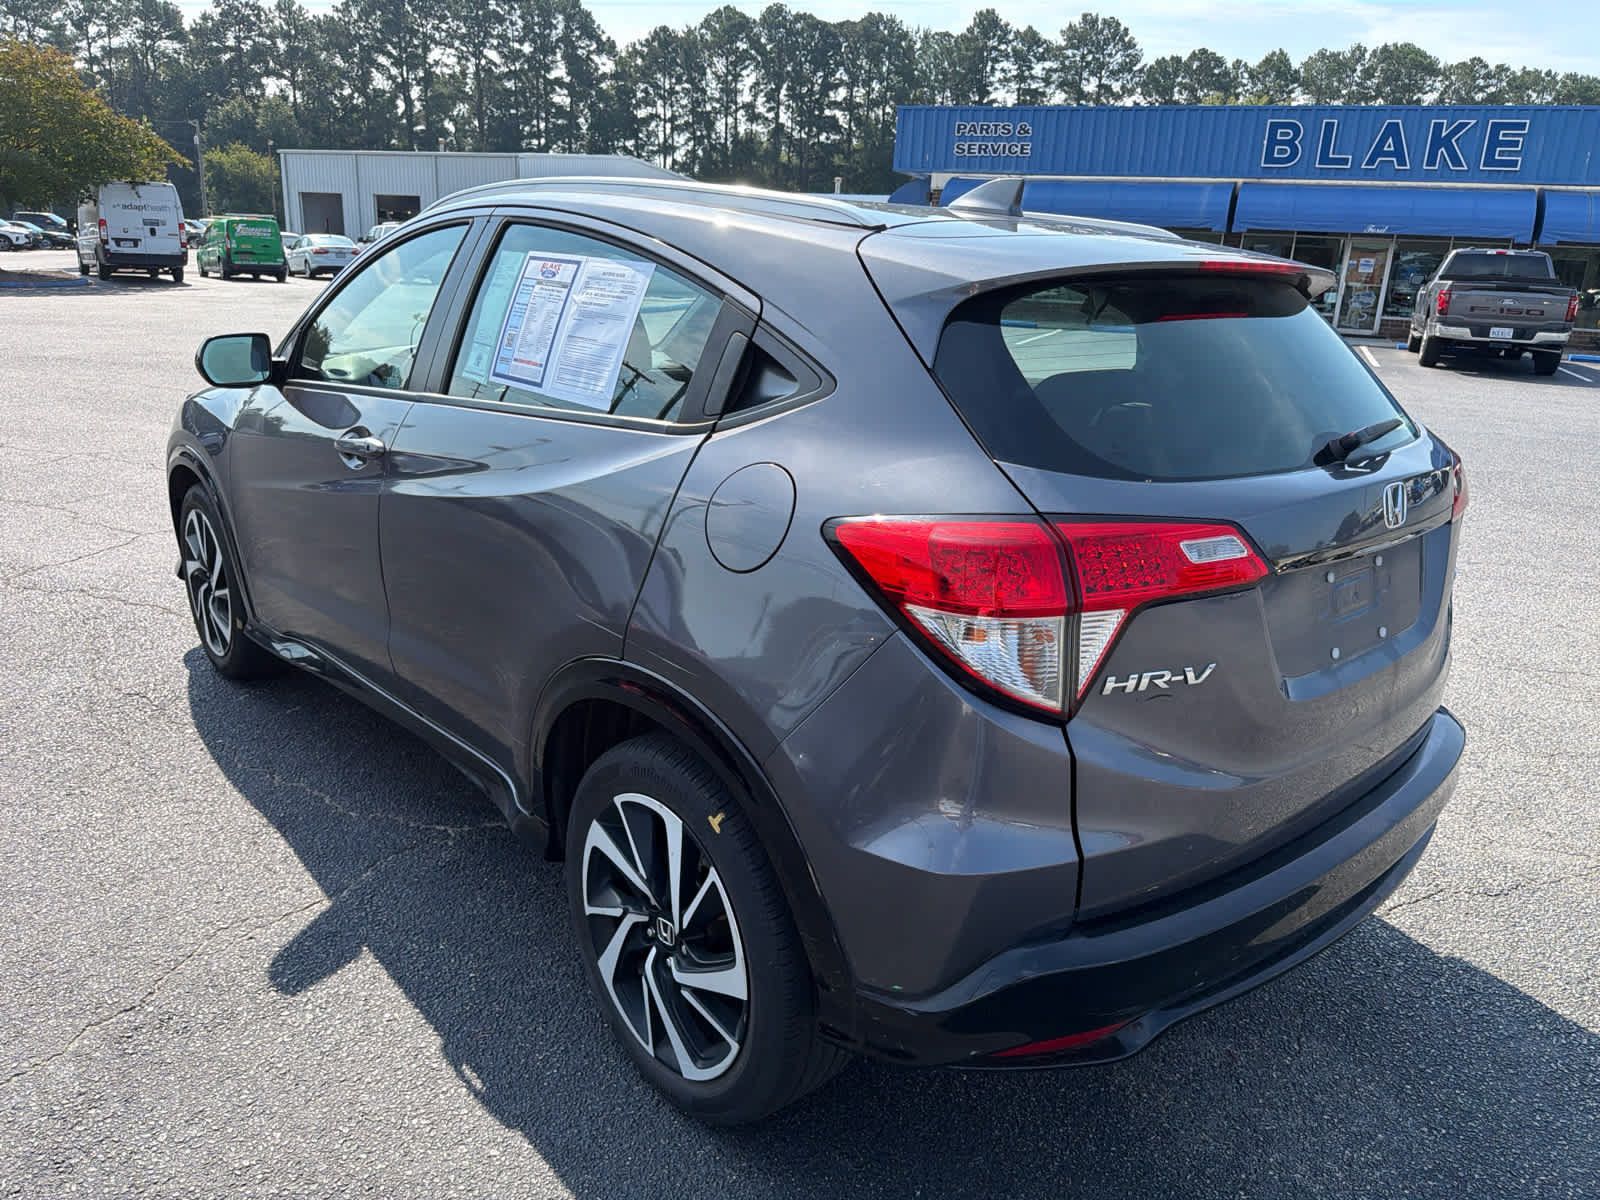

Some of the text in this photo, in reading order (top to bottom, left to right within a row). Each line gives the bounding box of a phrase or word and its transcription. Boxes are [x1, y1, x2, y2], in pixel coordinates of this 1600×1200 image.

[955, 122, 1032, 136] PARTS &
[954, 142, 1031, 156] SERVICE
[1261, 119, 1530, 171] BLAKE
[1469, 305, 1545, 317] F-150
[1102, 663, 1217, 695] HR-V
